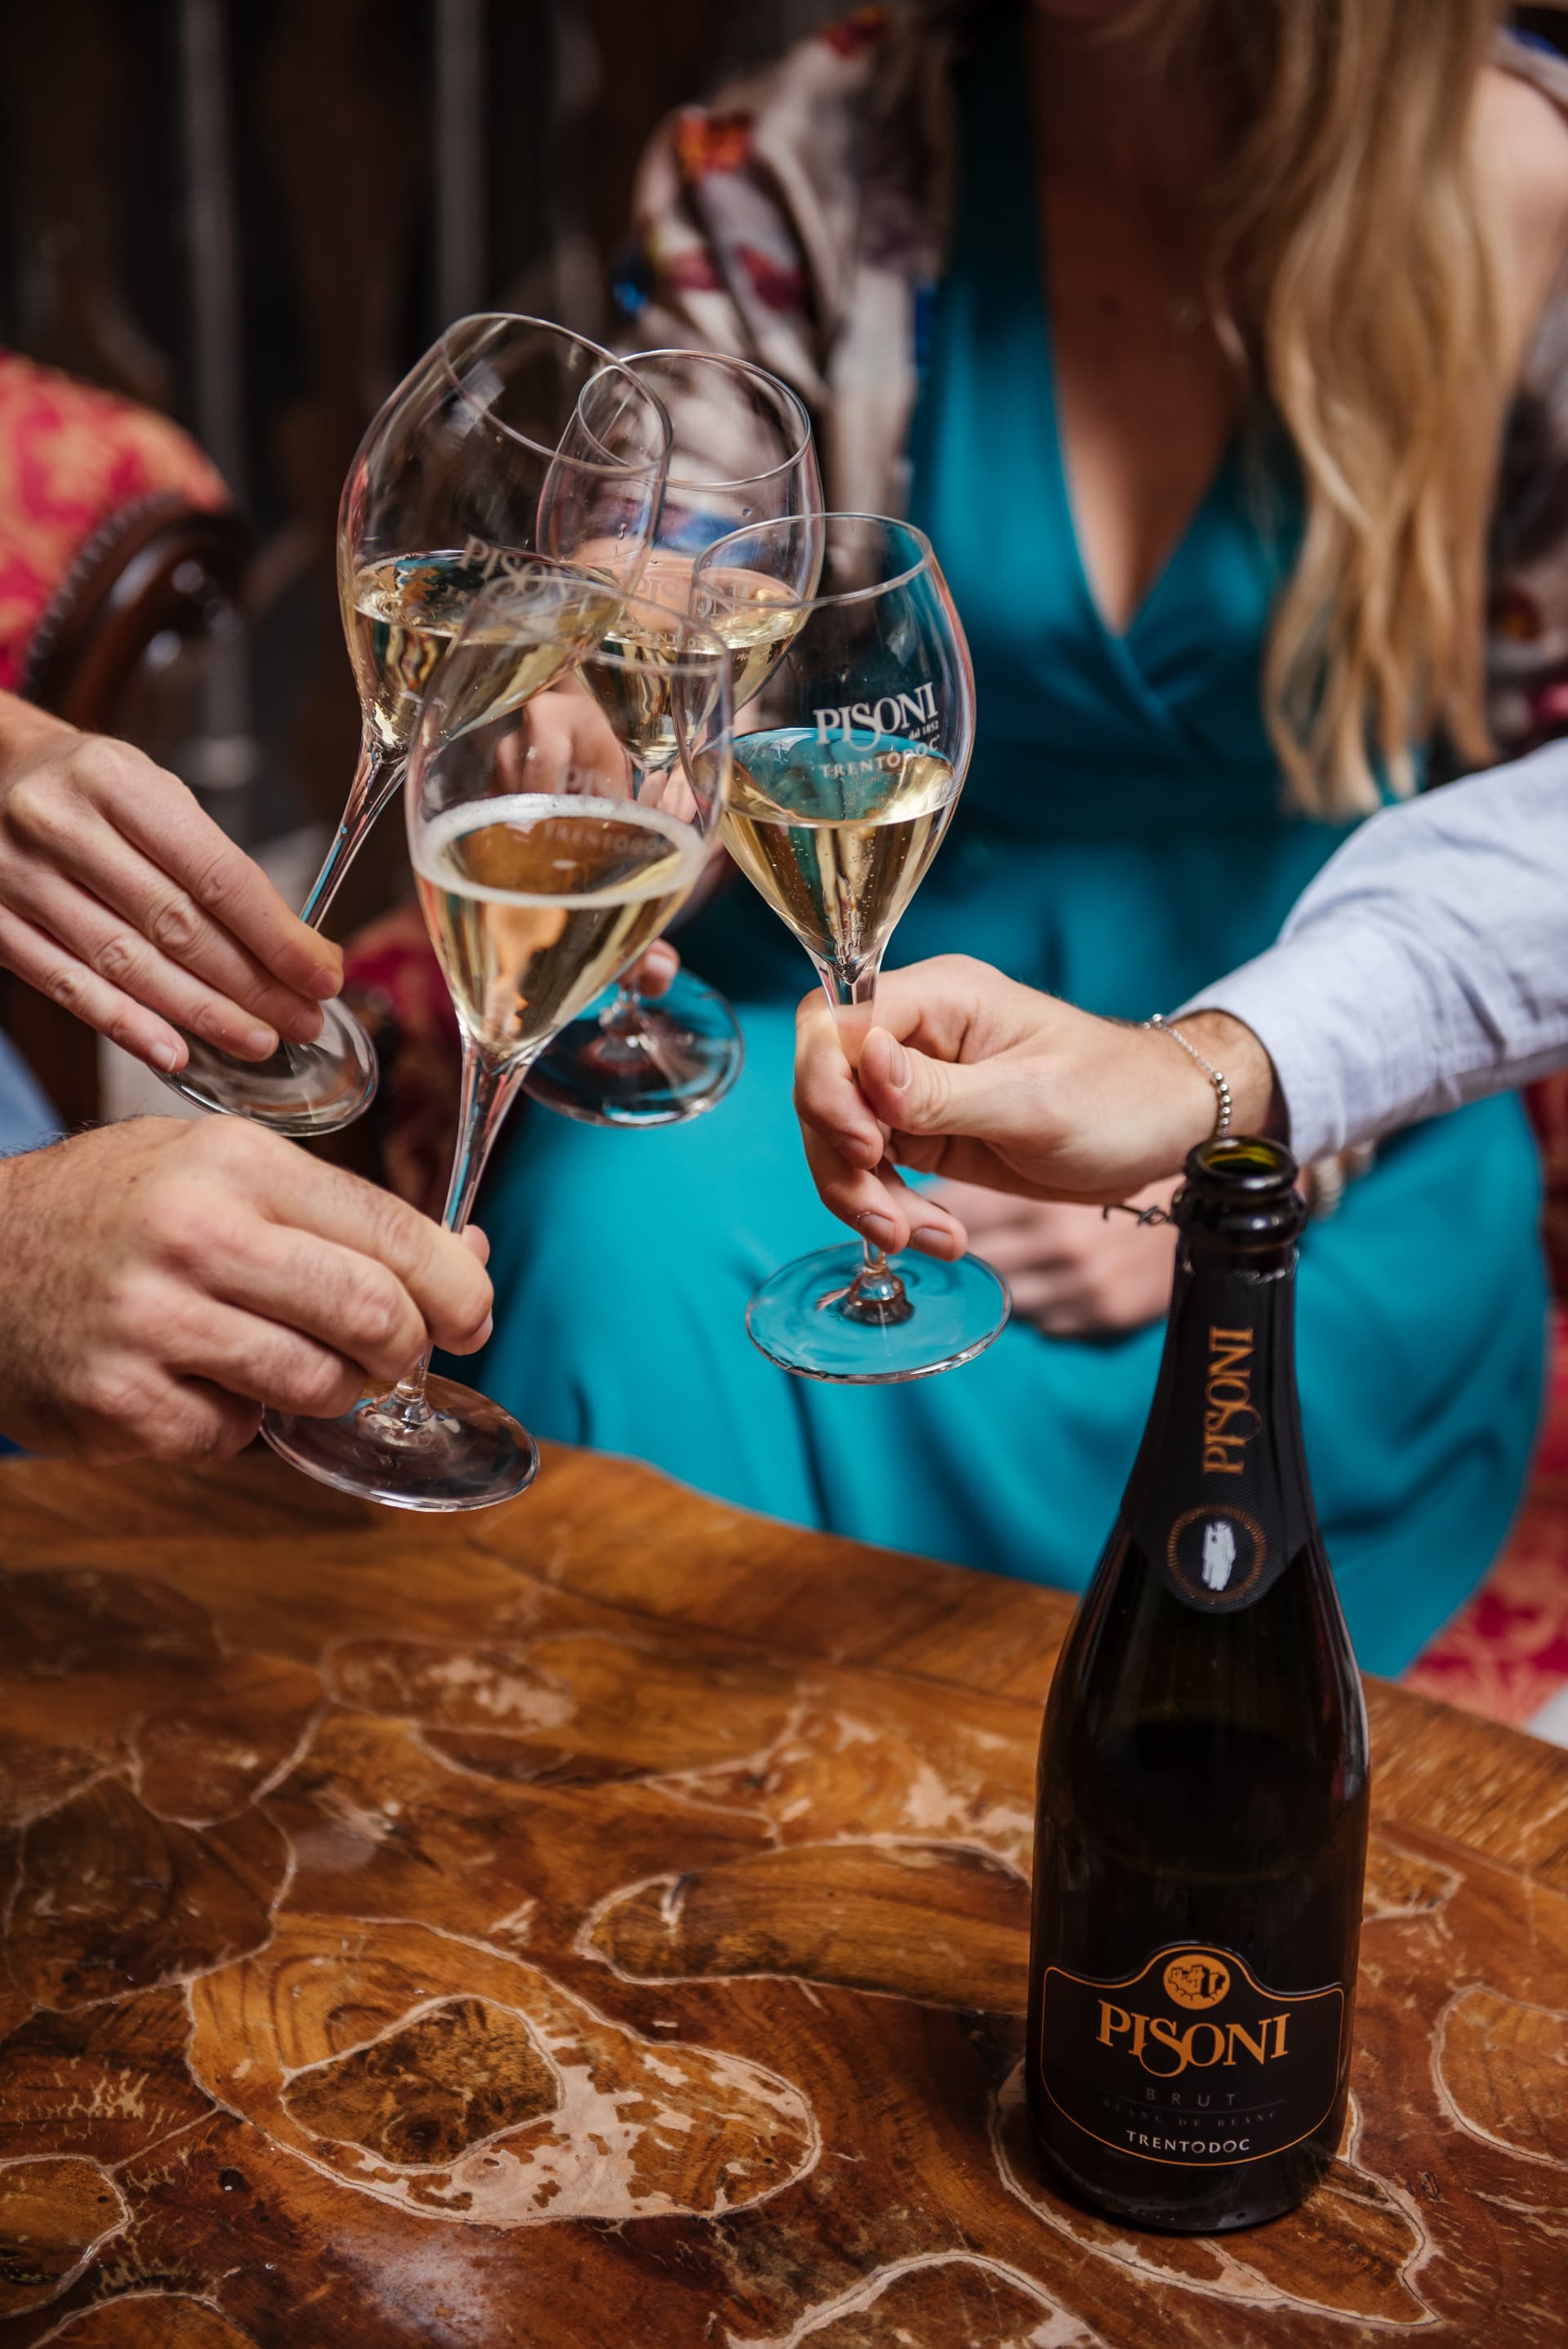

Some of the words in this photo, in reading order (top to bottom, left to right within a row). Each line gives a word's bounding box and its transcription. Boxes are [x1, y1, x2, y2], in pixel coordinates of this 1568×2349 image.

[813, 681, 938, 752] PISONI
[819, 733, 942, 779] TRENTODOC
[1202, 1326, 1262, 1477] PISONI
[1096, 1999, 1291, 2078] PISONI
[1145, 2087, 1236, 2109] BRUT
[1126, 2129, 1250, 2155] TRENTODOC
[1178, 2118, 1202, 2128] DE
